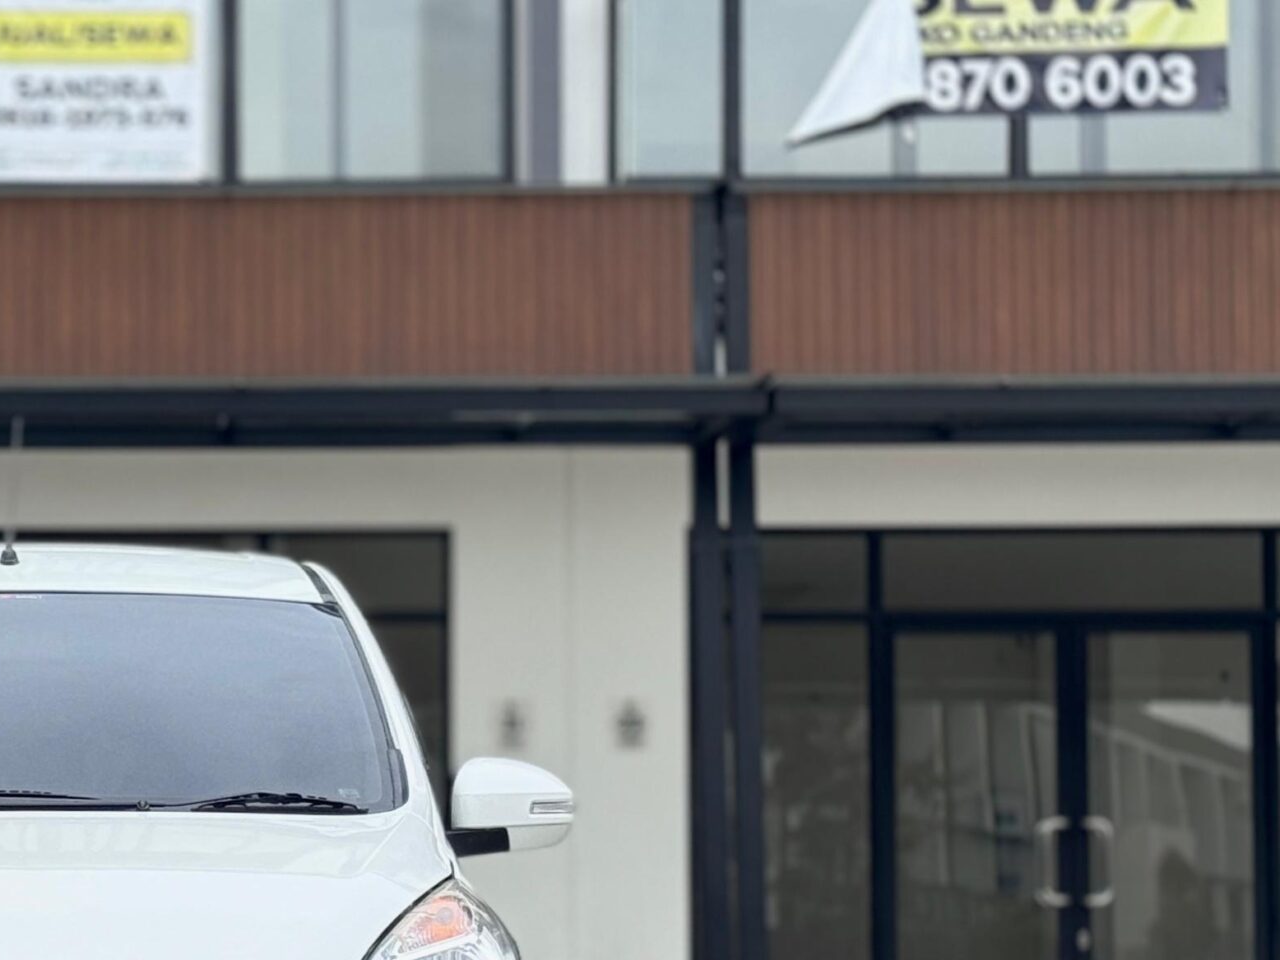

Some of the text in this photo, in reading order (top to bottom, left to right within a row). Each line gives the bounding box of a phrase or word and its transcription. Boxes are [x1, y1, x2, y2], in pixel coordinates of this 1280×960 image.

[13, 76, 166, 99] SANDRA
[925, 52, 1197, 111] 870 6003
